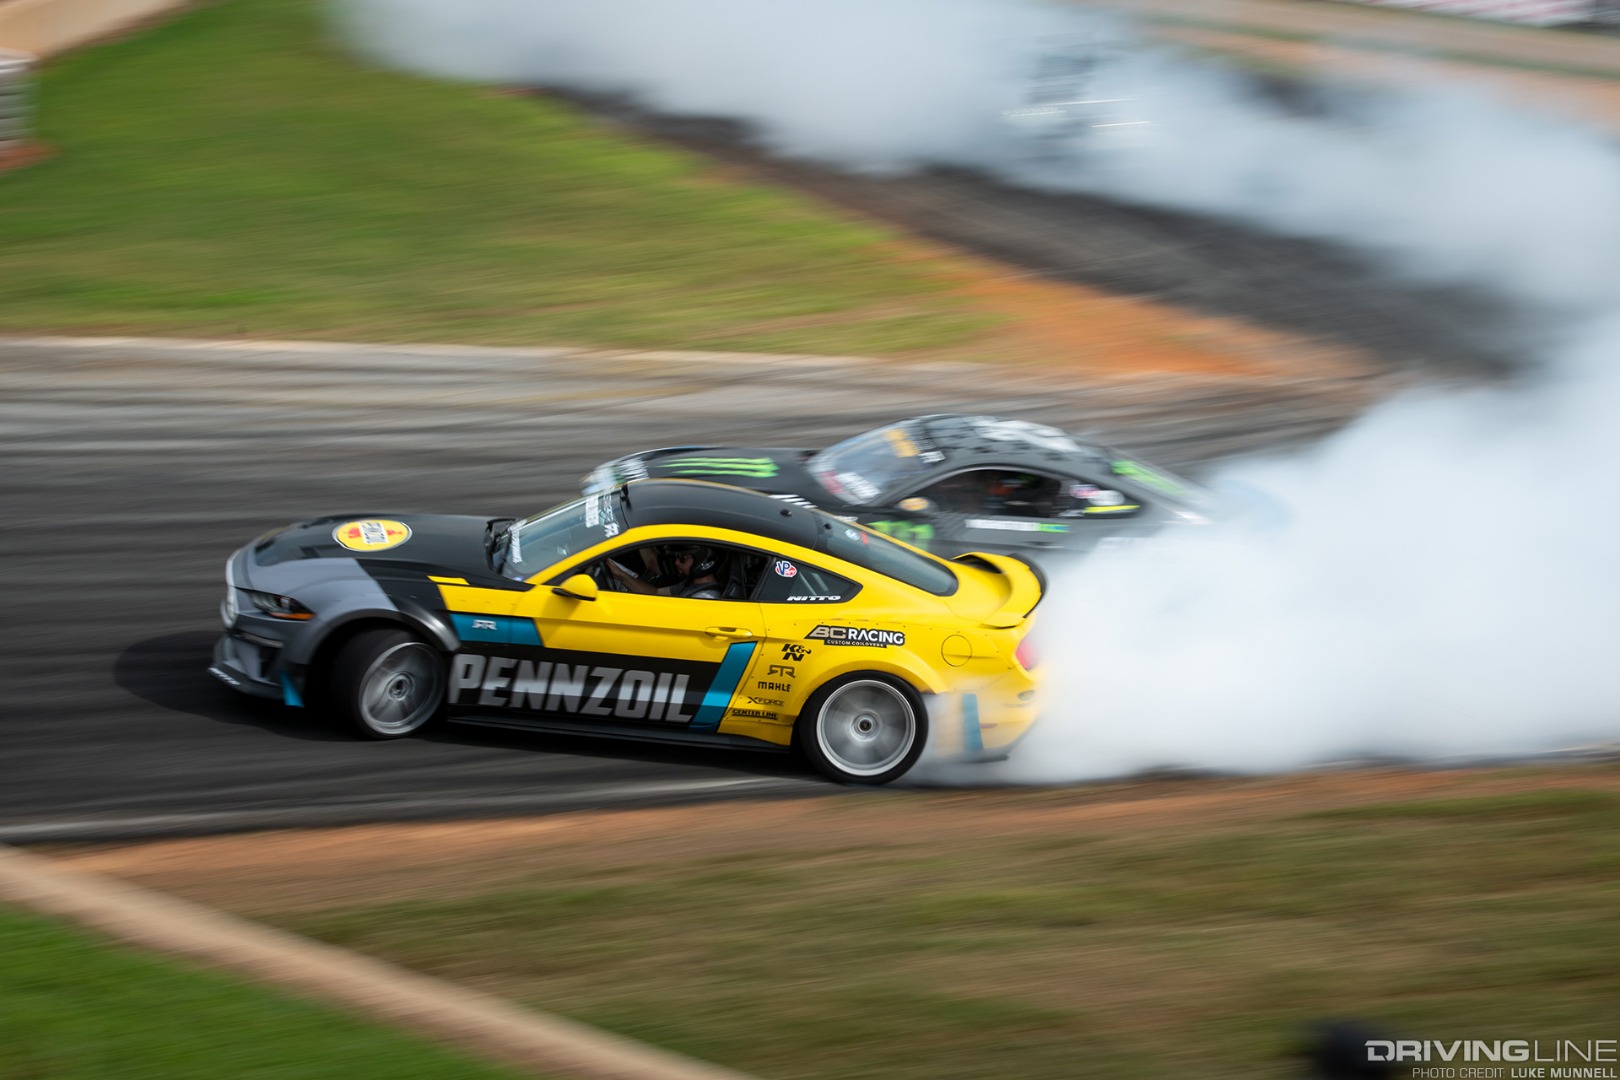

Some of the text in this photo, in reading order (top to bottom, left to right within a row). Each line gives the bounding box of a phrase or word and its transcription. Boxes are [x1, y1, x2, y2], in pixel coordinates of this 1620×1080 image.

[776, 561, 791, 576] VP
[809, 626, 904, 645] BC RACING
[448, 653, 694, 723] PENNZOIL
[757, 681, 791, 692] MAHLE
